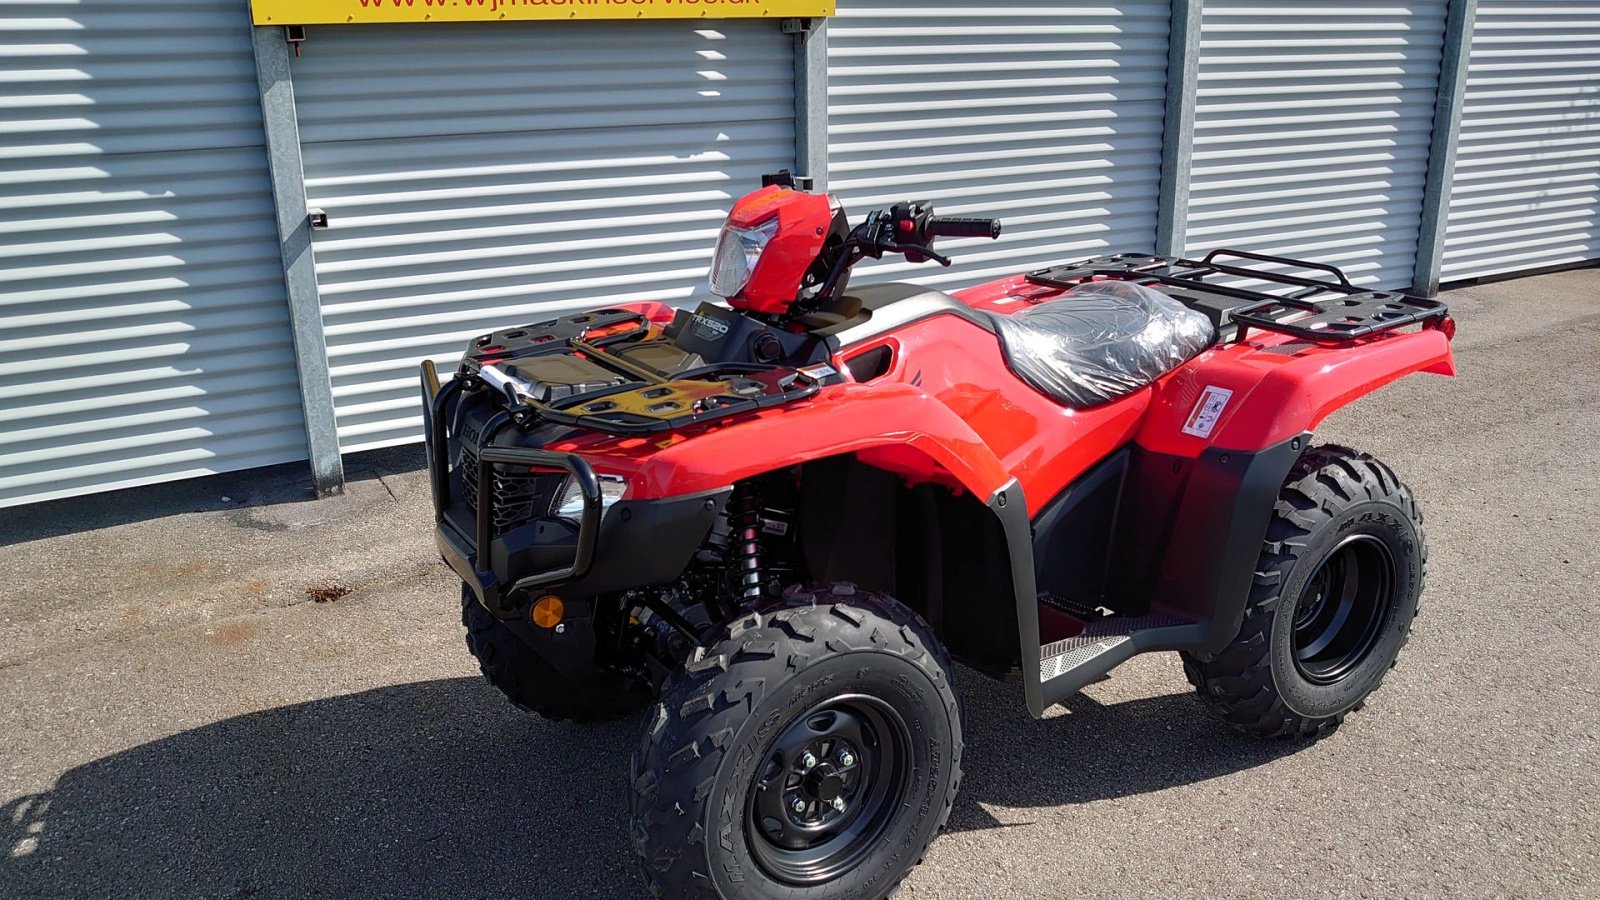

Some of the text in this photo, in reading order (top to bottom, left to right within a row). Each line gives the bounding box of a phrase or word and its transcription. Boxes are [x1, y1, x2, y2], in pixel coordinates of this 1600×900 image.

[692, 314, 729, 334] TRX520
[1335, 512, 1414, 555] MAXXIS
[719, 707, 781, 884] MAXXIS
